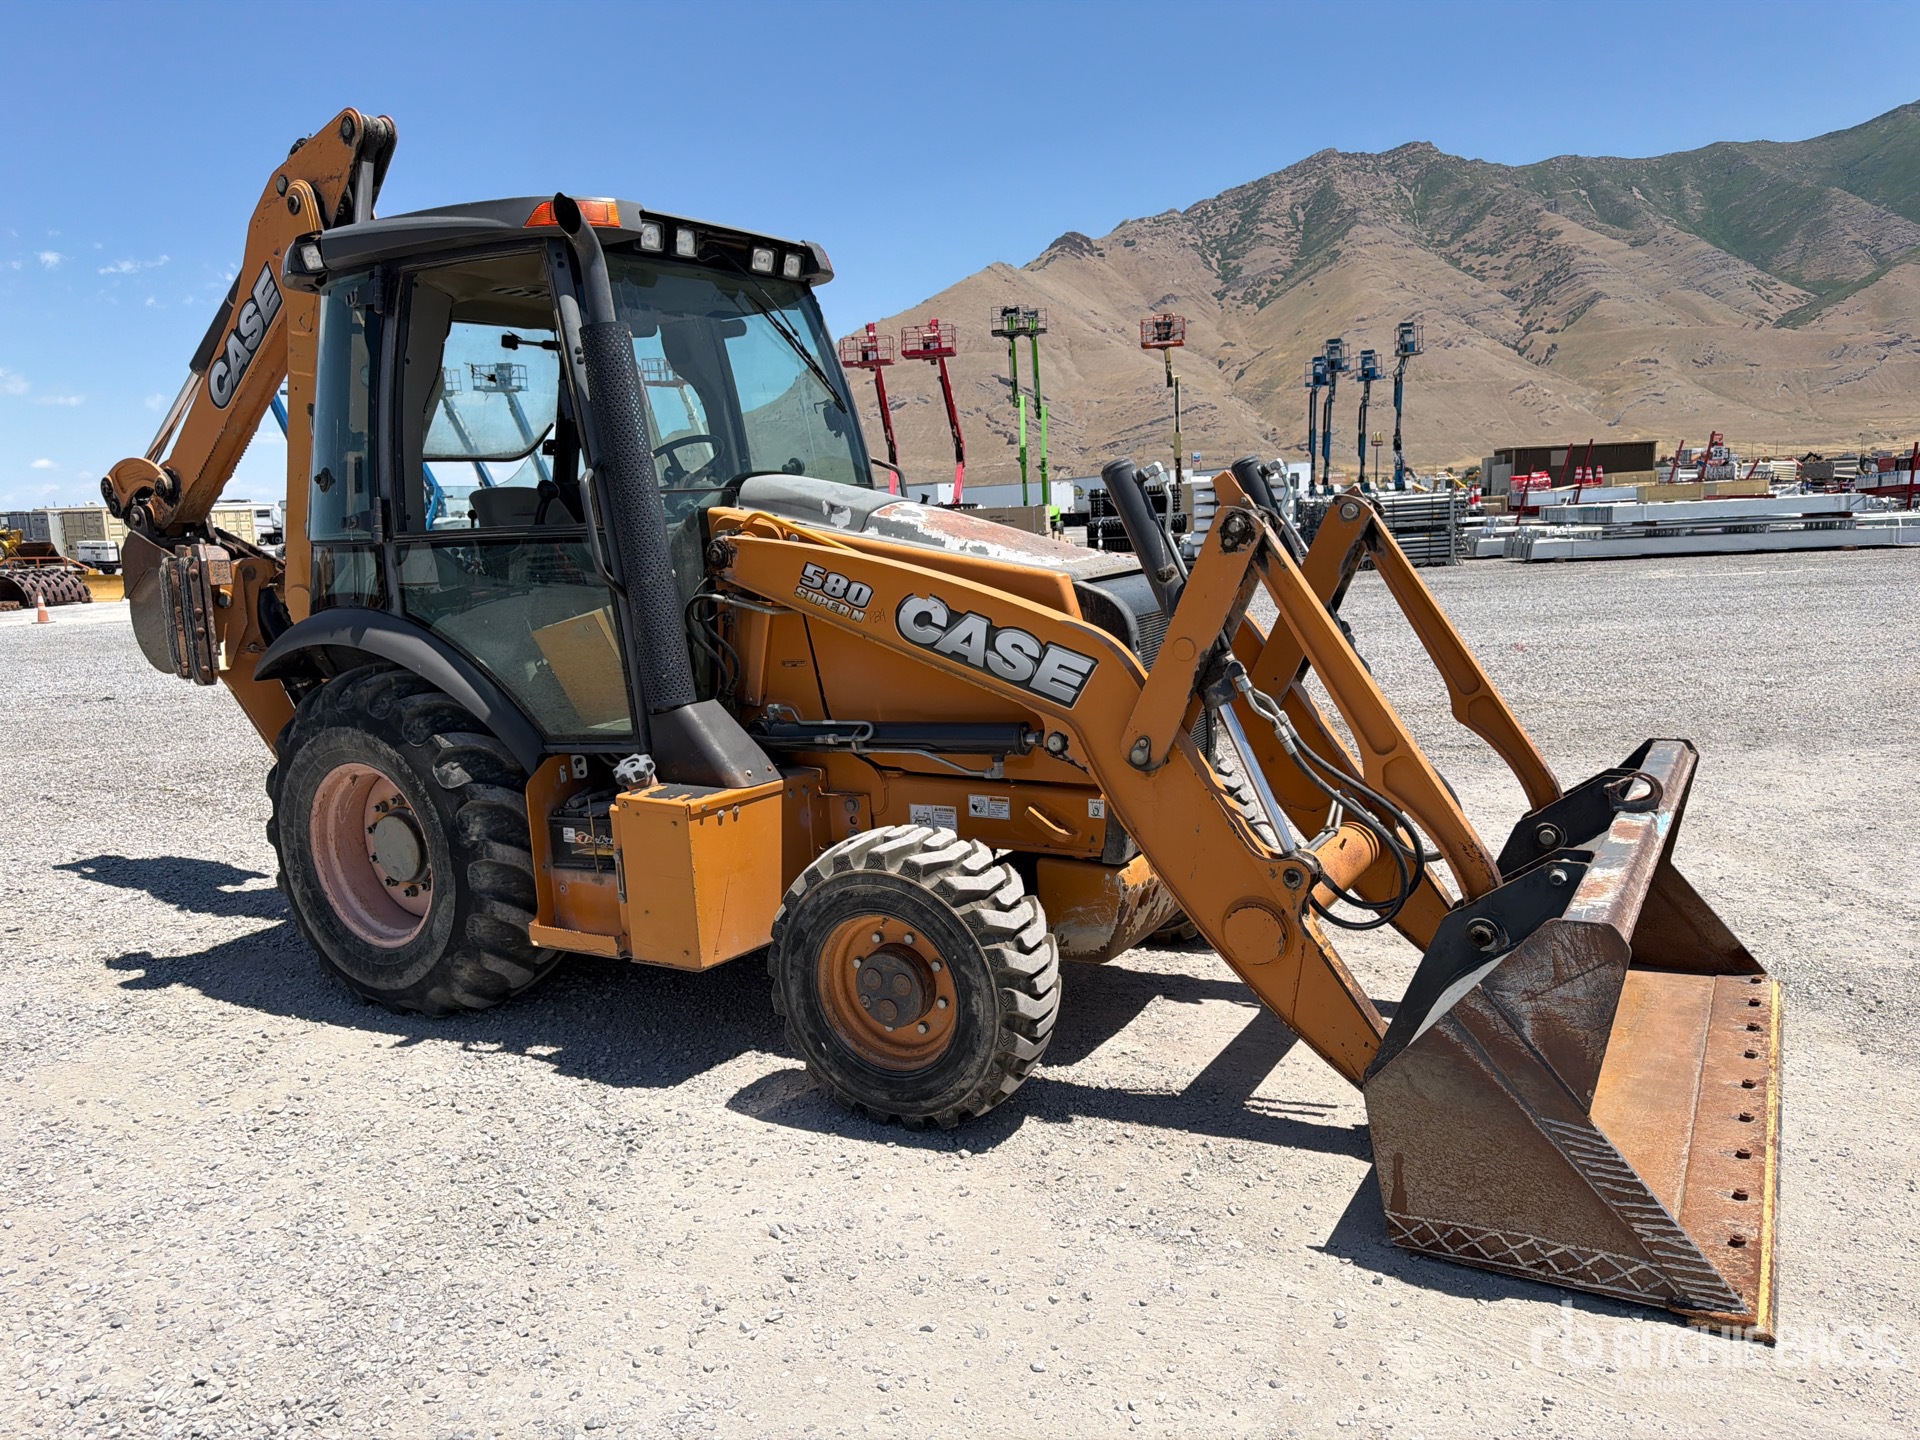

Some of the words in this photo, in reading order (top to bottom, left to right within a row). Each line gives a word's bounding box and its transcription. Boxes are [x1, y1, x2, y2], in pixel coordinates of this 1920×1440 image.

[208, 261, 283, 409] CASE
[794, 586, 851, 617] SUPER
[849, 608, 866, 623] N
[799, 561, 874, 608] 580
[895, 593, 1099, 709] CASE
